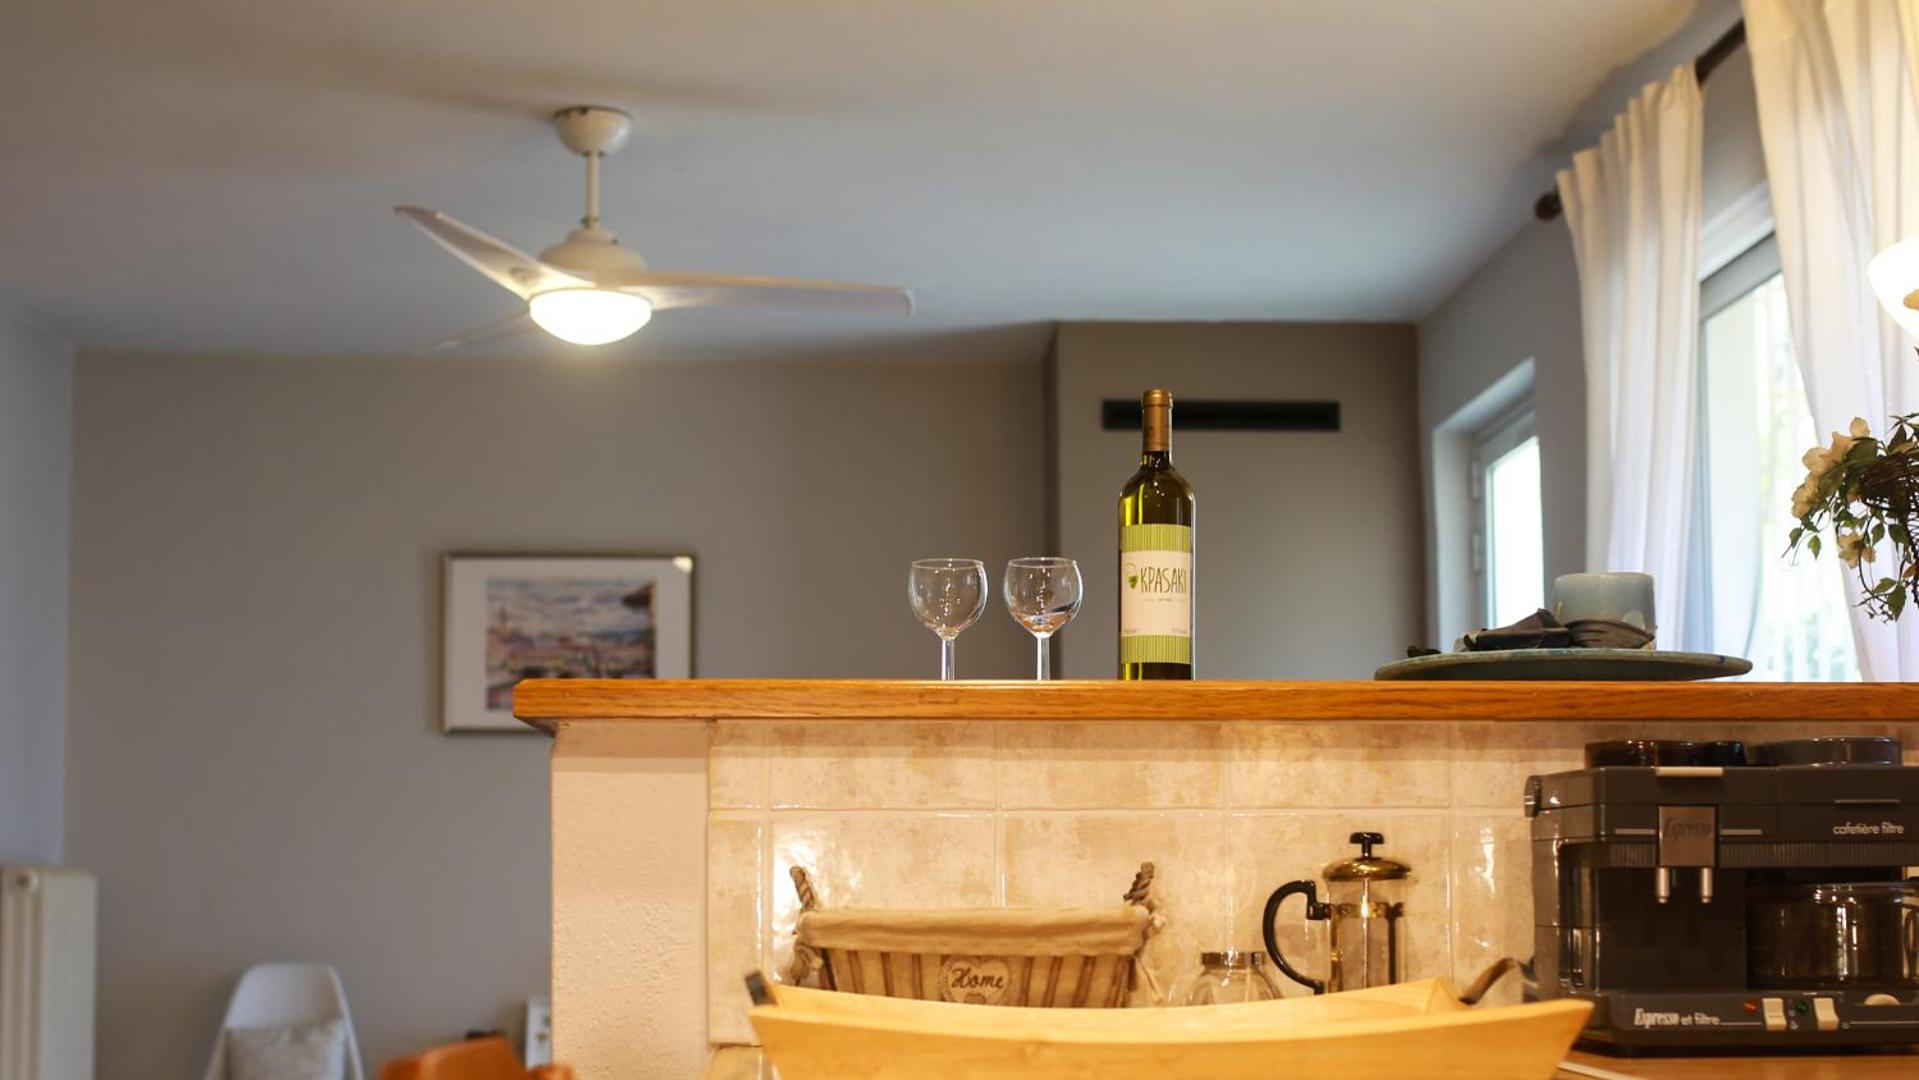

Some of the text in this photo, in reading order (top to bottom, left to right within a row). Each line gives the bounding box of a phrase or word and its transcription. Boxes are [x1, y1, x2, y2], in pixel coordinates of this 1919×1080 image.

[1881, 821, 1905, 834] filtre
[951, 966, 1005, 989] Home
[1680, 1014, 1693, 1026] et
[1694, 1011, 1721, 1026] filtre
